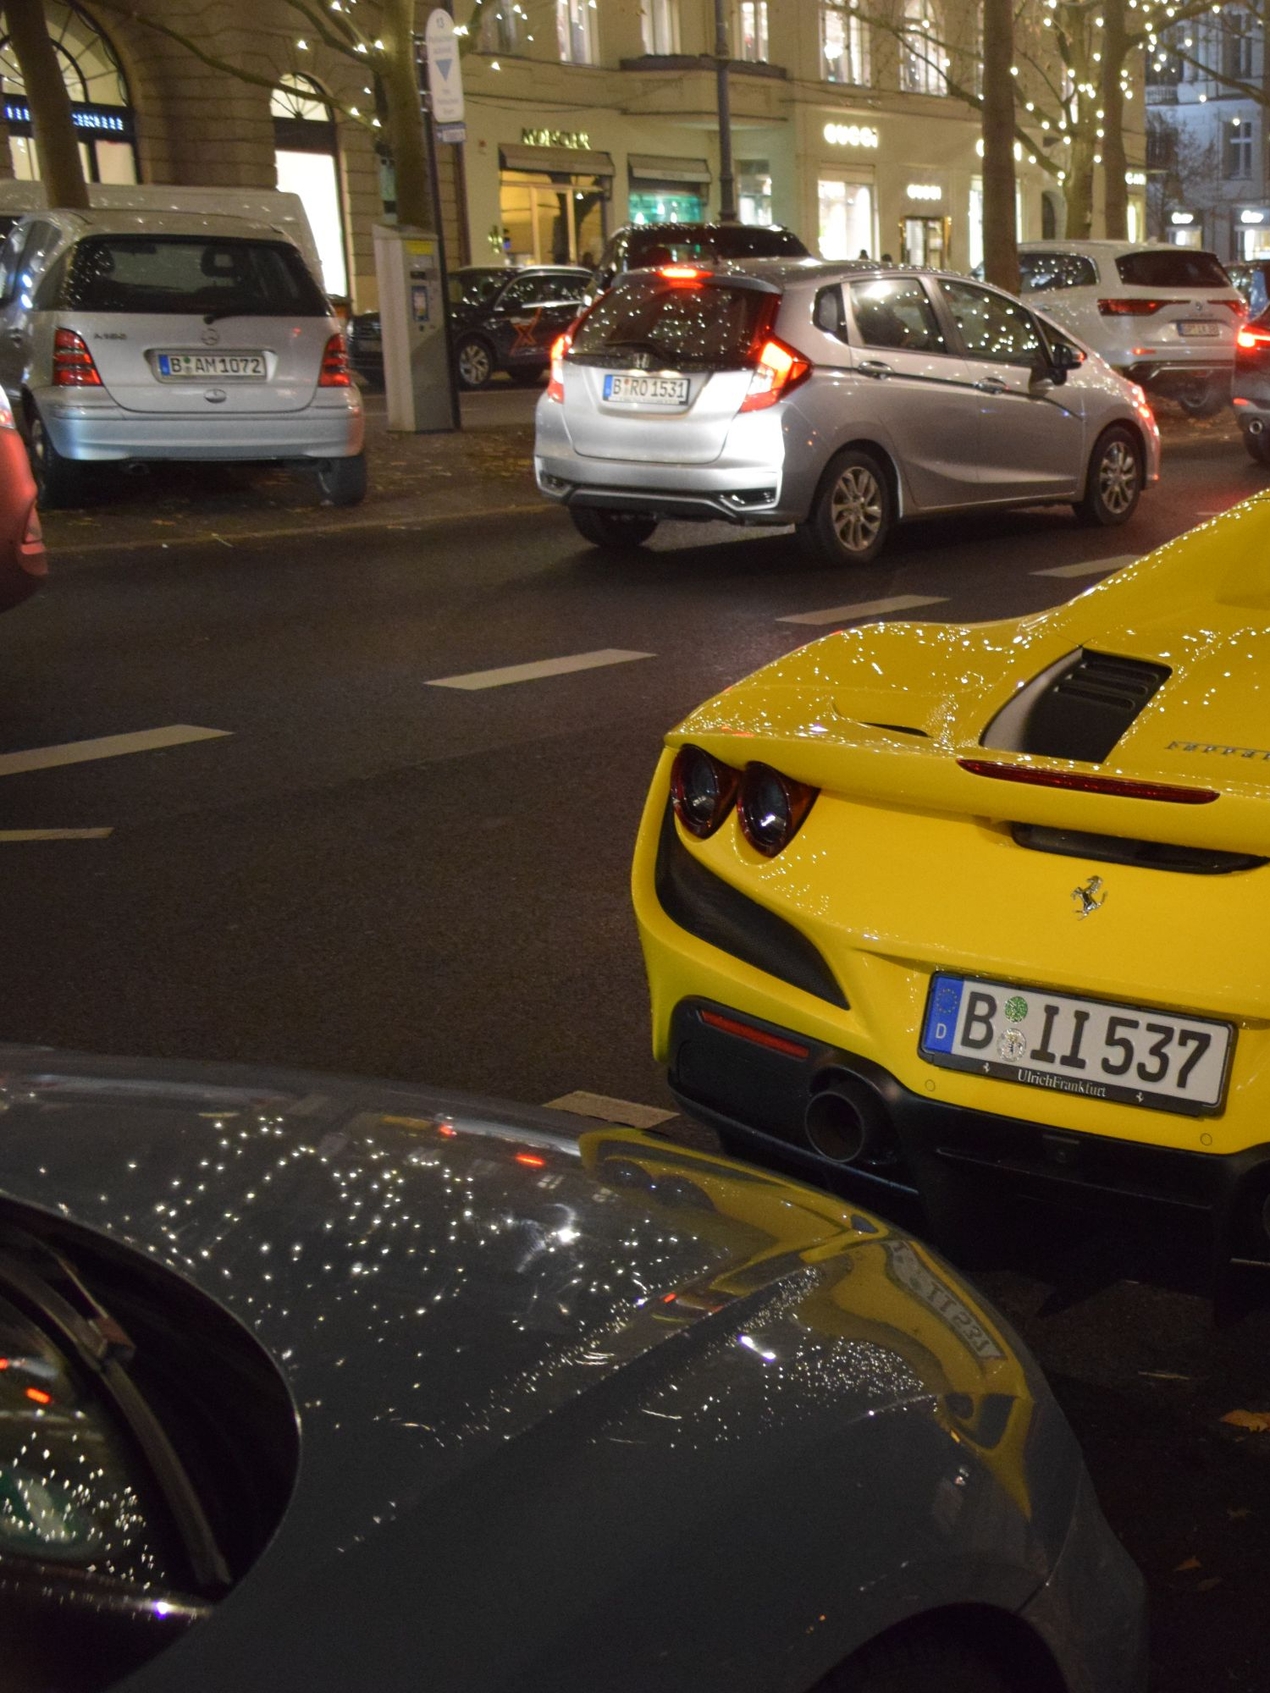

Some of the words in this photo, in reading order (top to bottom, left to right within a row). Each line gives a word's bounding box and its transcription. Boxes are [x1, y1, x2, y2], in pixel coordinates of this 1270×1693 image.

[935, 1023, 947, 1040] D
[960, 991, 998, 1049] B
[1101, 1015, 1212, 1089] 537
